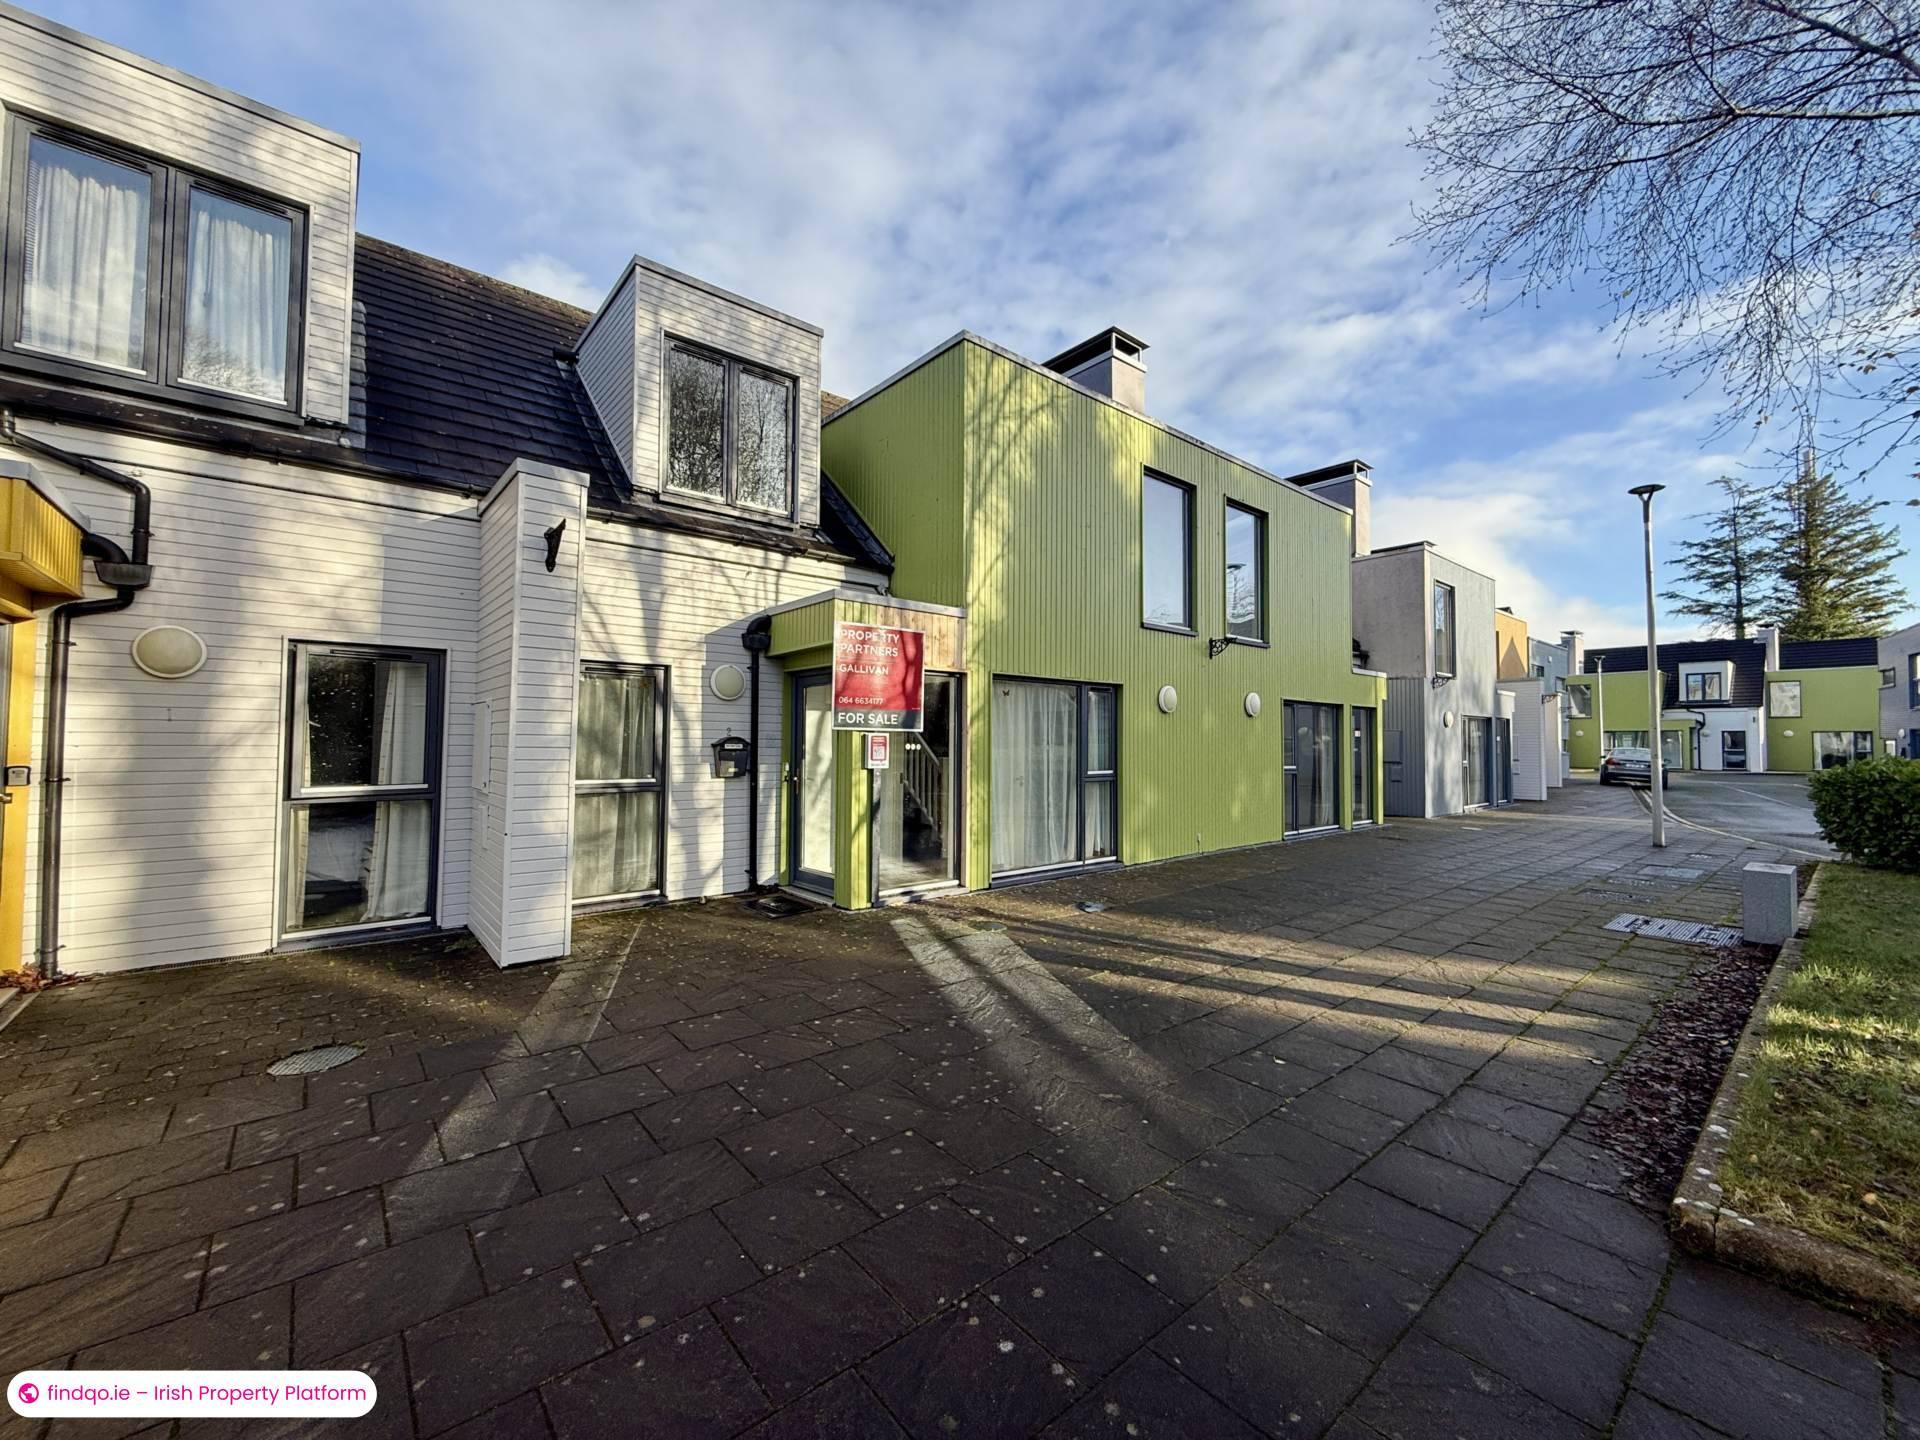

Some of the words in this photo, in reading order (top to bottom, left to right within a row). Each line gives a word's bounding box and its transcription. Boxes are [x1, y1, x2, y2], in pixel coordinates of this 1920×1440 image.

[840, 630, 900, 643] PROPERTY
[840, 643, 898, 656] PARTNERS
[840, 664, 888, 674] GALLIVAN
[838, 712, 864, 724] FOR
[868, 714, 898, 724] SALE
